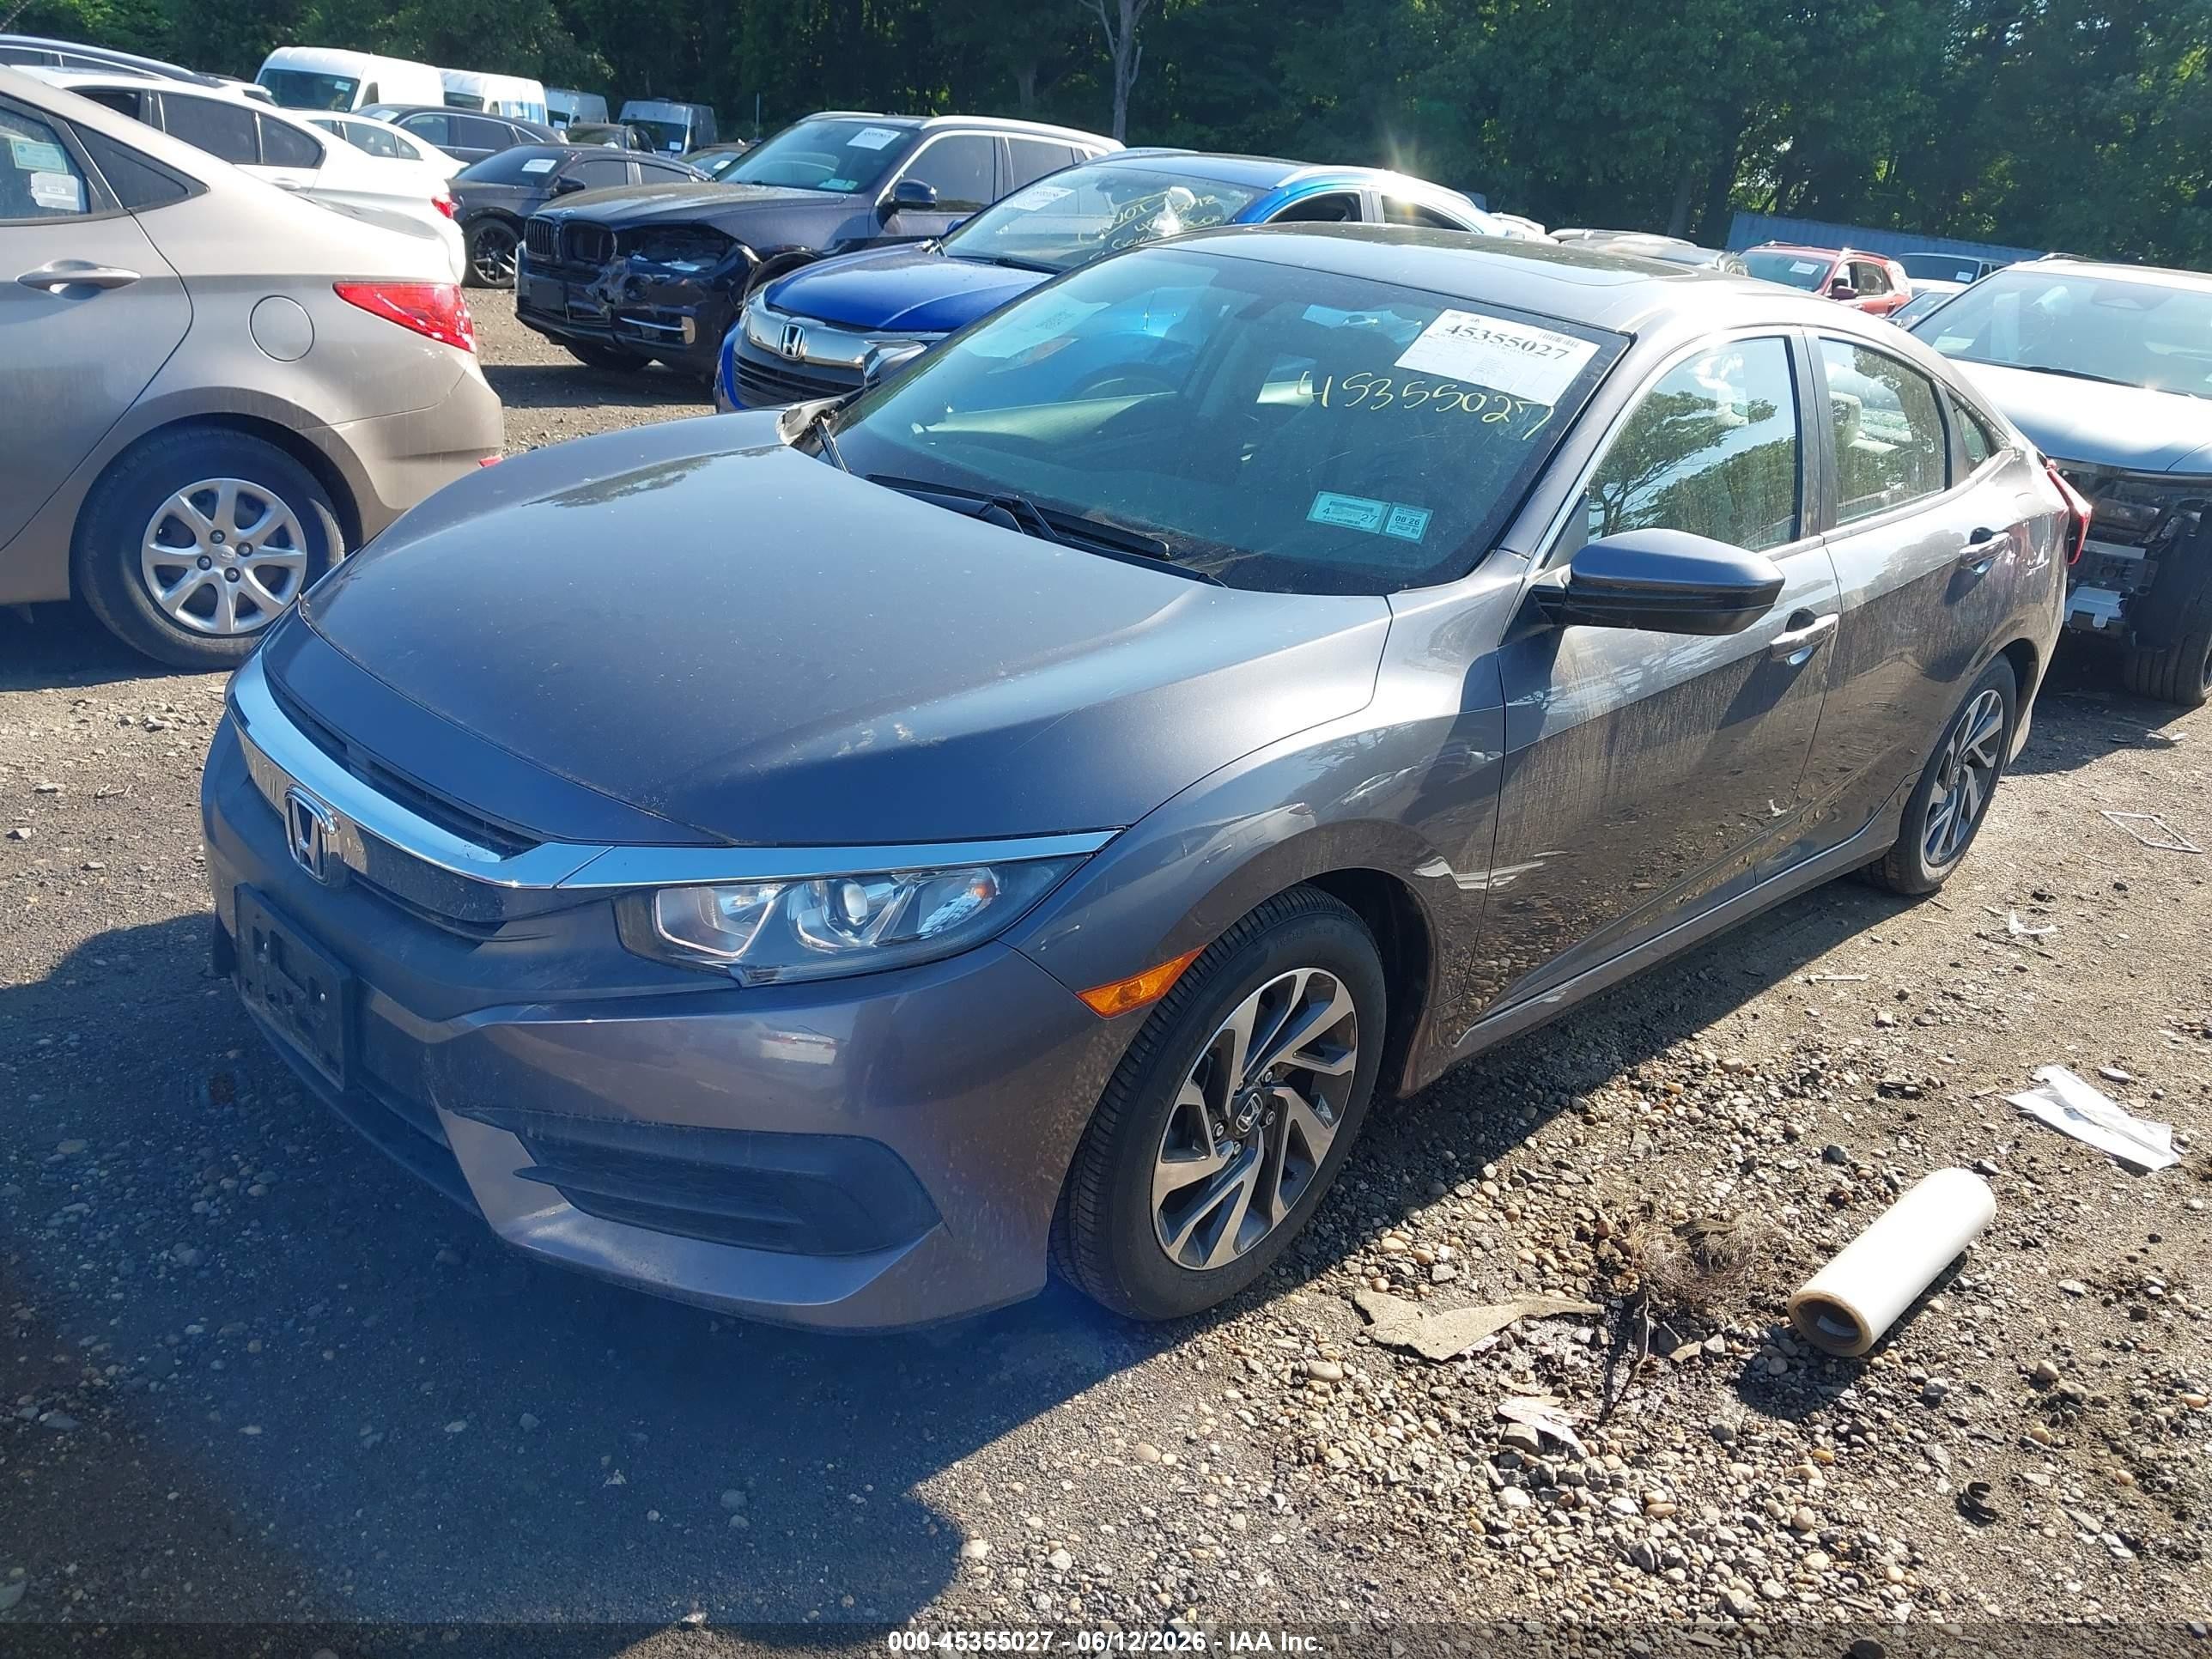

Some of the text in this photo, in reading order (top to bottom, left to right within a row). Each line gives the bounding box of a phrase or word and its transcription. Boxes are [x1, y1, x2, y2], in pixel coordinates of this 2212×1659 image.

[1445, 324, 1570, 360] 45355027
[1297, 371, 1555, 441] 45355027
[1359, 514, 1377, 524] 27
[1408, 517, 1421, 526] 26
